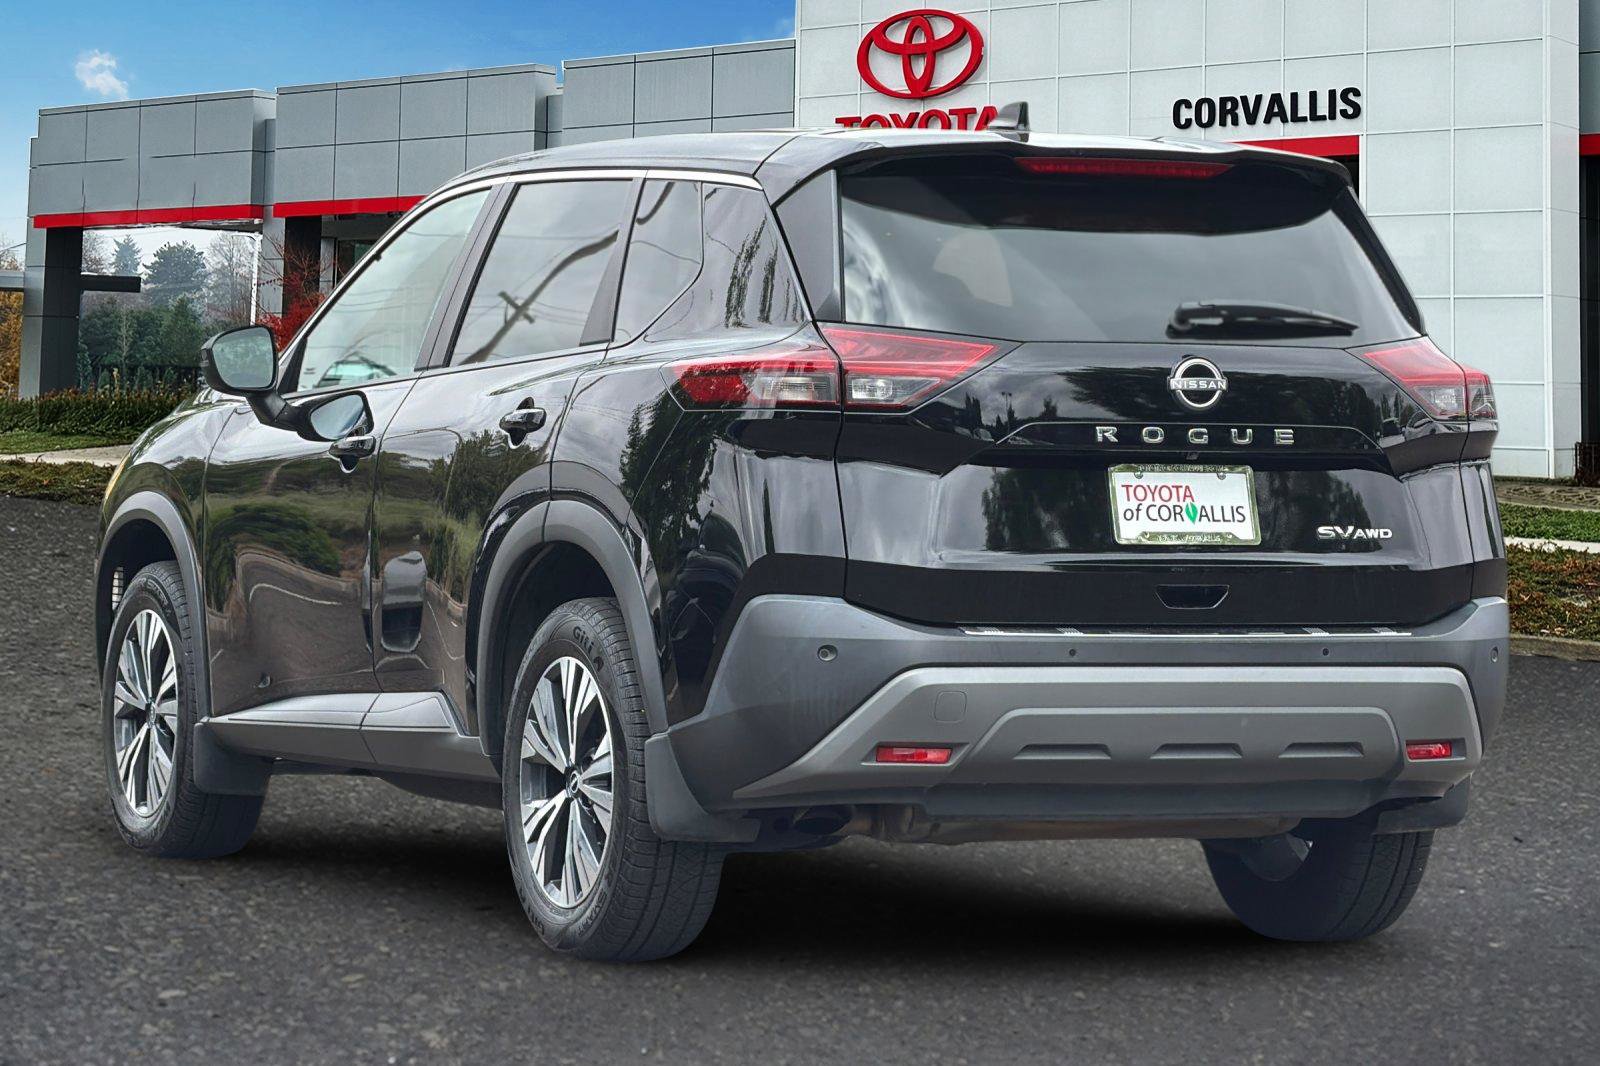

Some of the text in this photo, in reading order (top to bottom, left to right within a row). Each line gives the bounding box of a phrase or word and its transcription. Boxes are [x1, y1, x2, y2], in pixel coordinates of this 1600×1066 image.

[1172, 87, 1362, 130] CORVALLIS
[1171, 379, 1227, 390] NISSAN
[1095, 426, 1295, 445] ROGUE
[1121, 484, 1195, 503] TOYOTA
[1123, 503, 1142, 522] of
